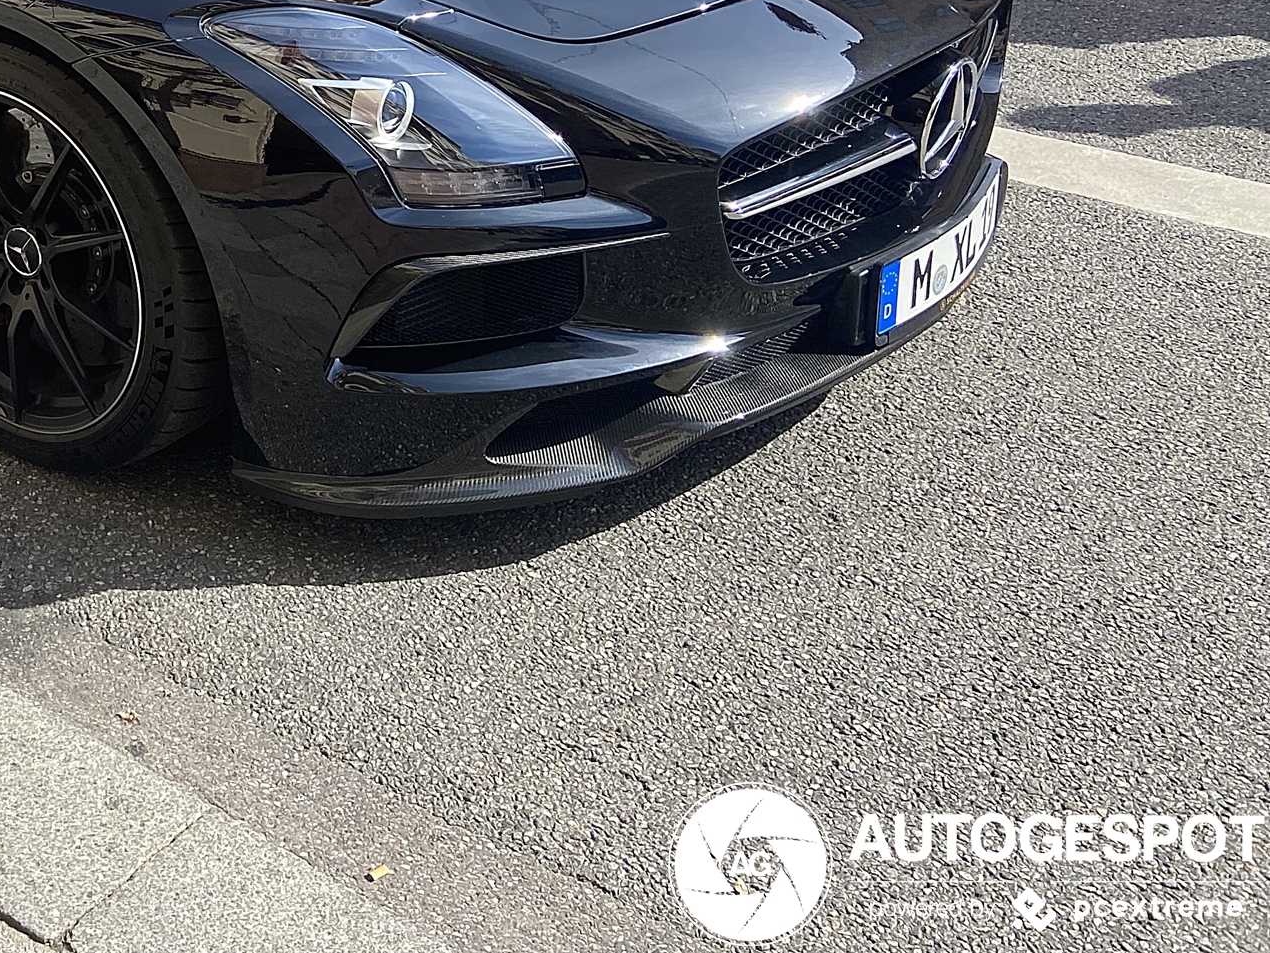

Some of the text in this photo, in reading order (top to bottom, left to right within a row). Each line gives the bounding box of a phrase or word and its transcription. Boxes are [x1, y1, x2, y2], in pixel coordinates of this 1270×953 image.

[910, 249, 934, 309] M
[950, 219, 977, 284] XL
[883, 303, 892, 320] D
